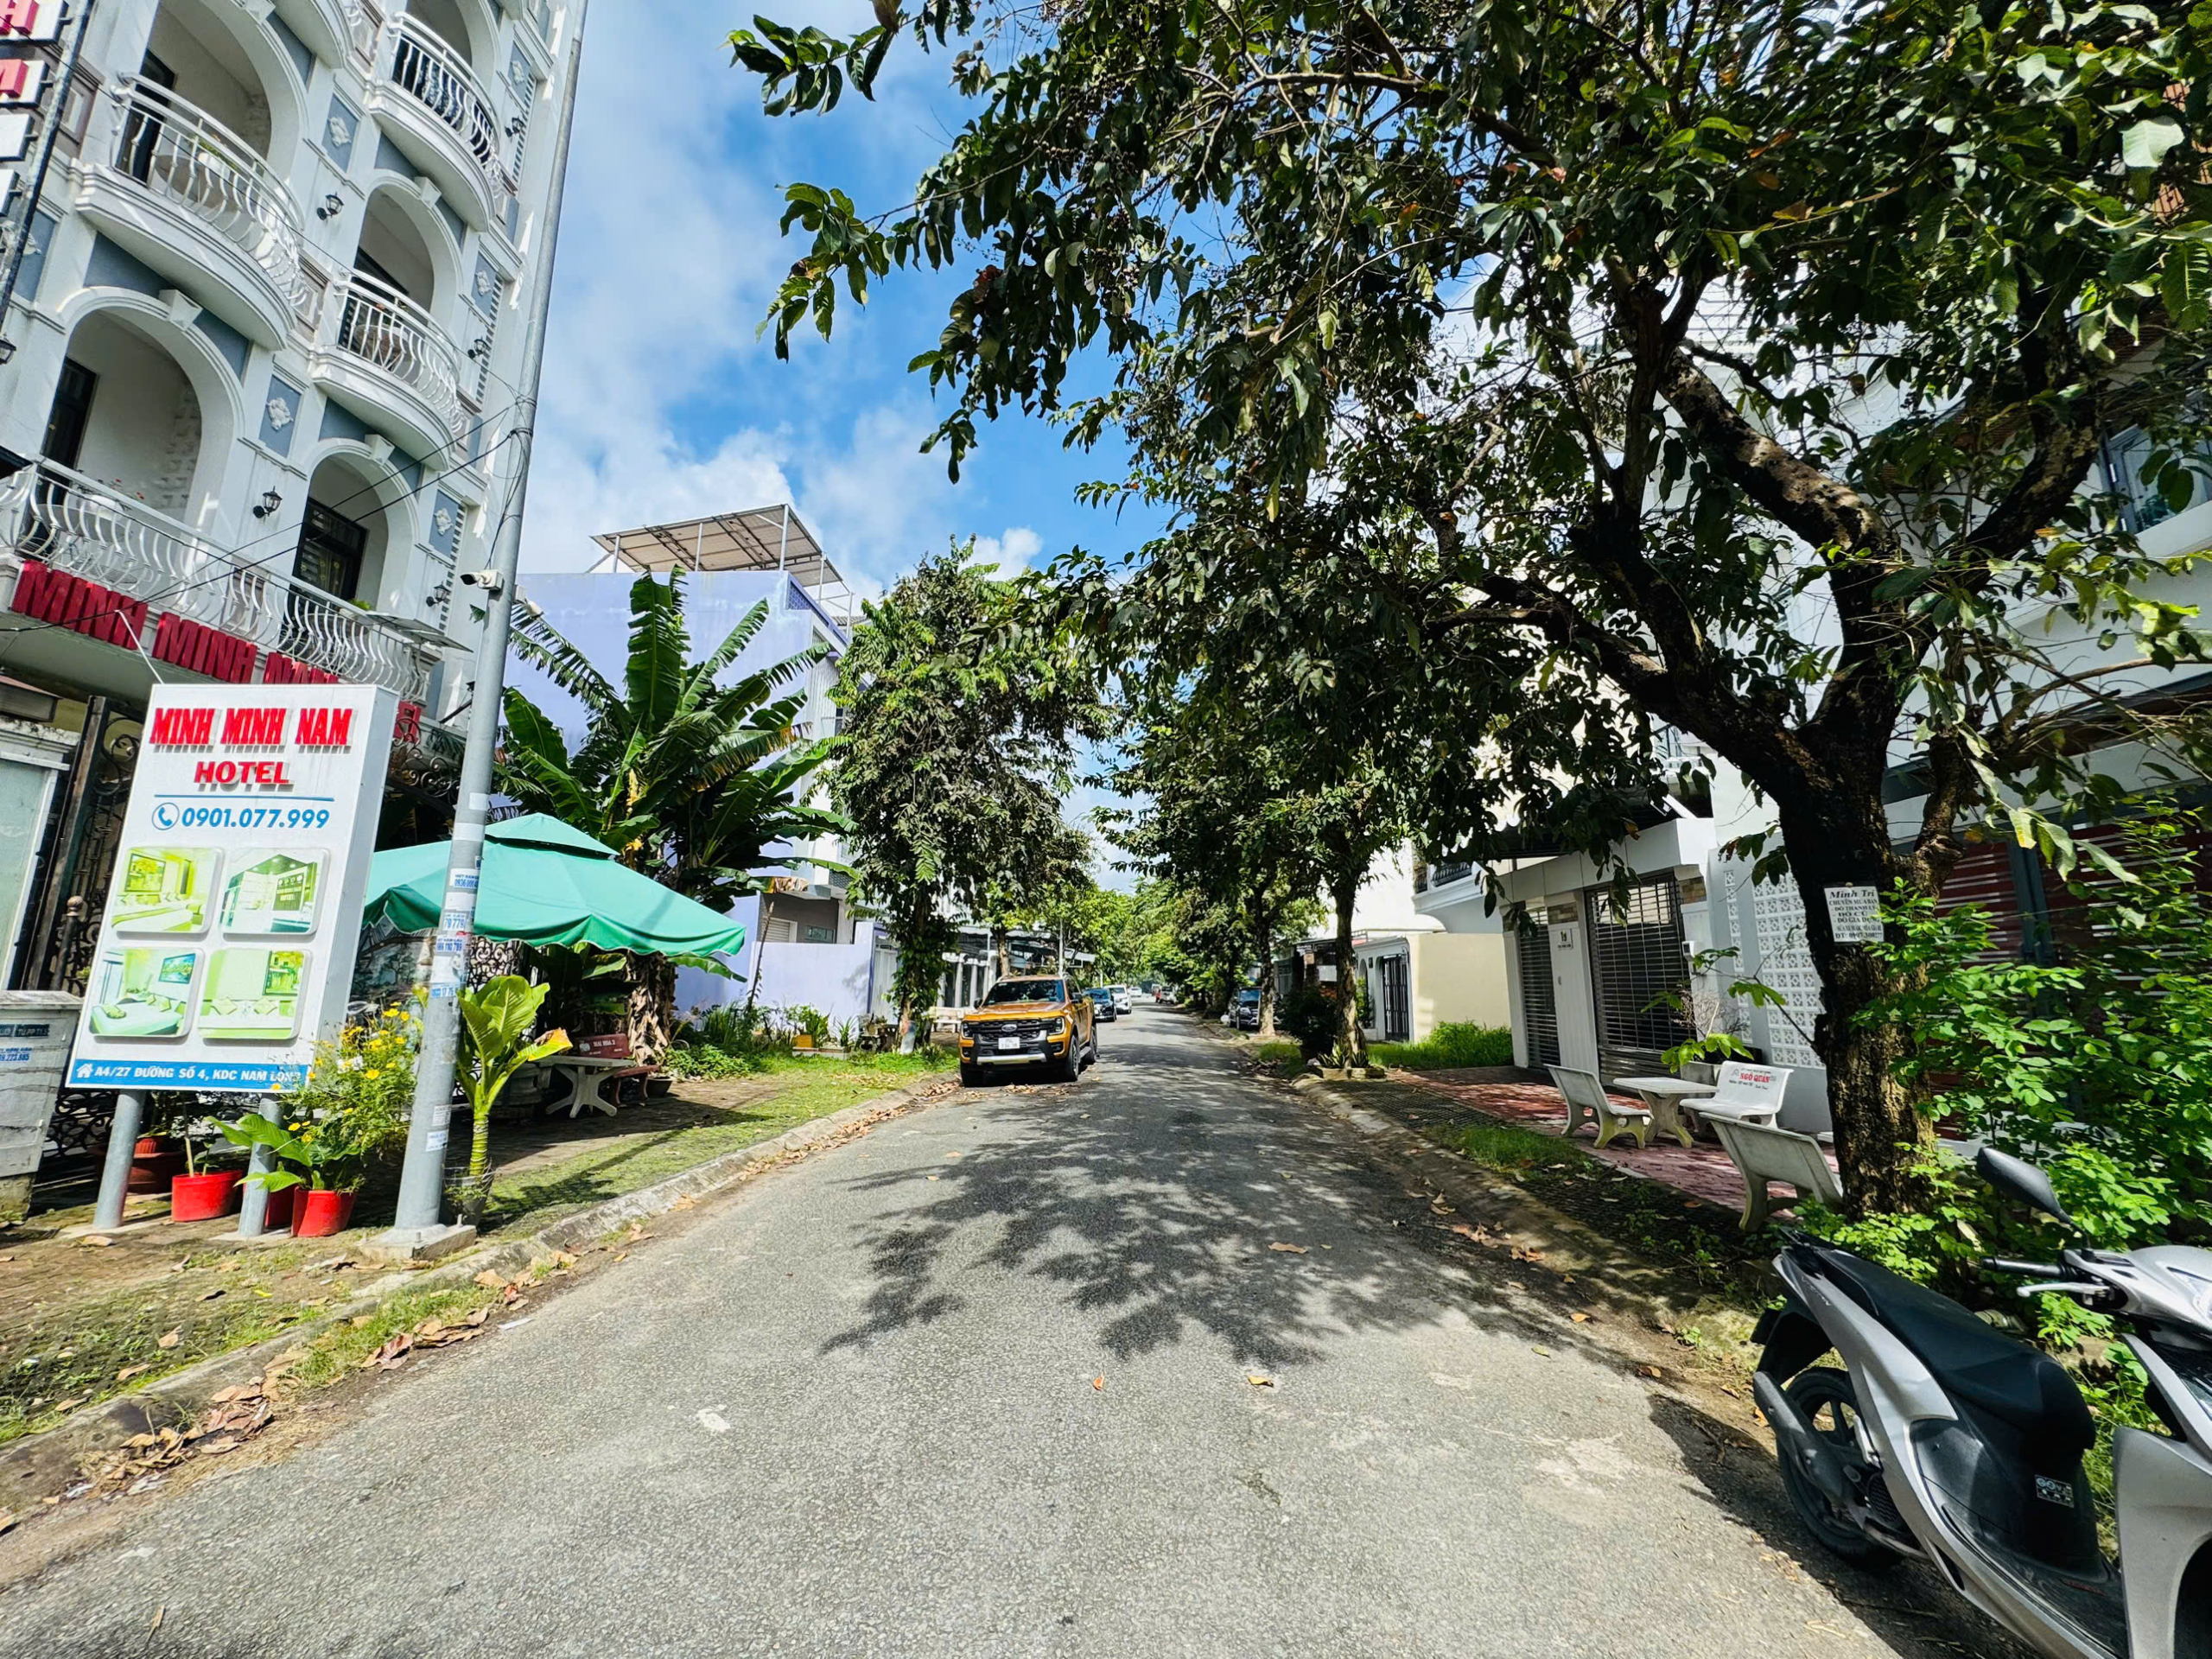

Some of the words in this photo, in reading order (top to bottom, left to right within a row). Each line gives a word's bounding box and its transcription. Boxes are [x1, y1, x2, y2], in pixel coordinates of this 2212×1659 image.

[12, 559, 148, 651] MINH
[152, 611, 258, 683] MINH
[149, 708, 215, 745] MINH
[220, 708, 286, 745] MINH
[295, 708, 353, 746] NAM
[194, 760, 289, 784] HOTEL
[181, 807, 330, 828] 0901.077.999
[94, 1066, 131, 1077] A4/27
[134, 1064, 175, 1078] ĐƯỜNG
[179, 1065, 196, 1079] SỐ
[213, 1069, 238, 1080] KDC
[240, 1069, 267, 1081] NAM
